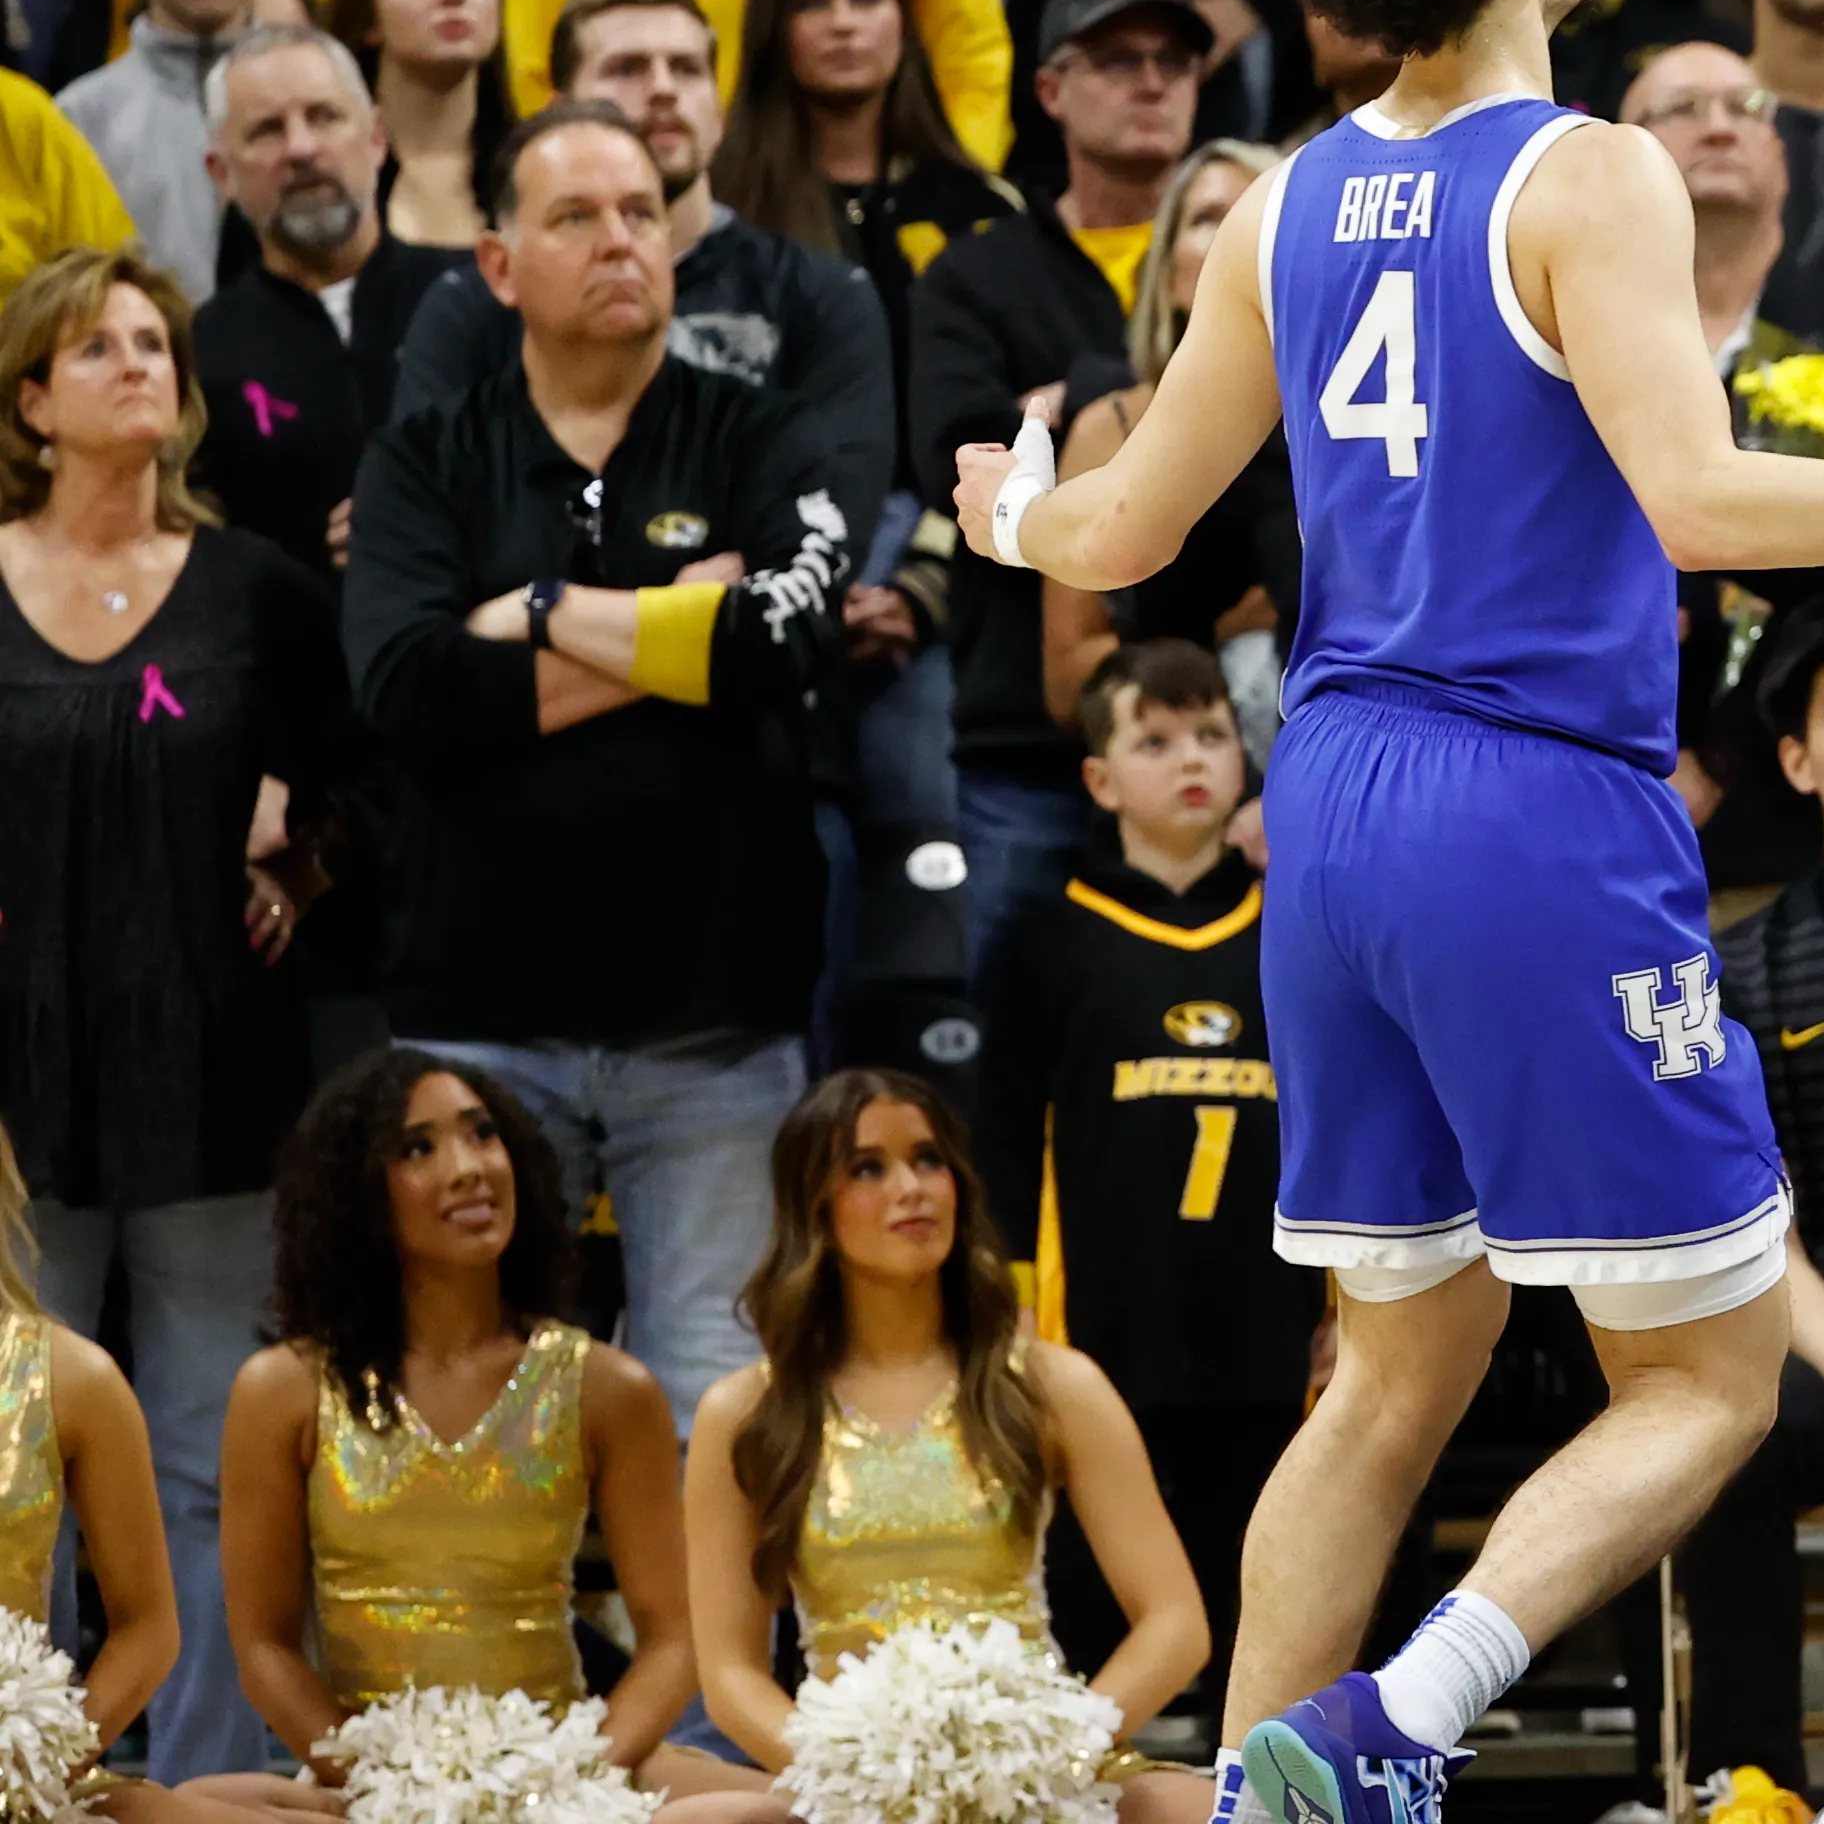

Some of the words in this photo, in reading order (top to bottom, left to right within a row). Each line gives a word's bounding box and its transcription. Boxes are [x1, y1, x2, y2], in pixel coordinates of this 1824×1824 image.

[1333, 170, 1437, 244] BREA
[1318, 270, 1428, 478] 4
[1177, 1104, 1239, 1221] 1
